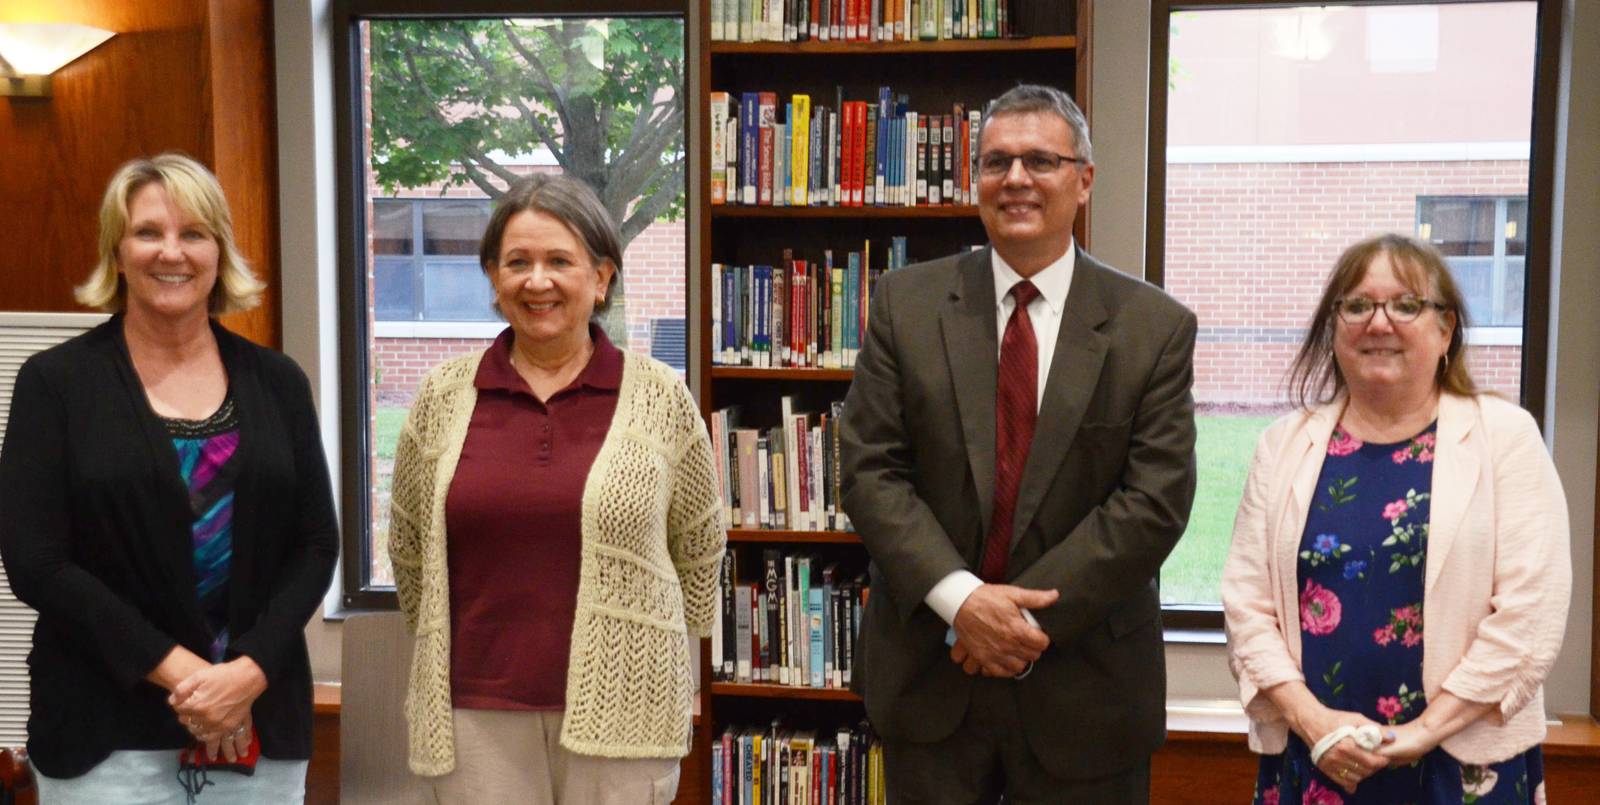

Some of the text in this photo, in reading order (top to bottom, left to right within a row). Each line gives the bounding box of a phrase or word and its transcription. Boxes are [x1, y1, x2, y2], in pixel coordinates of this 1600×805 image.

[764, 130, 772, 144] The
[760, 145, 772, 170] Sewing
[766, 567, 778, 603] MGM
